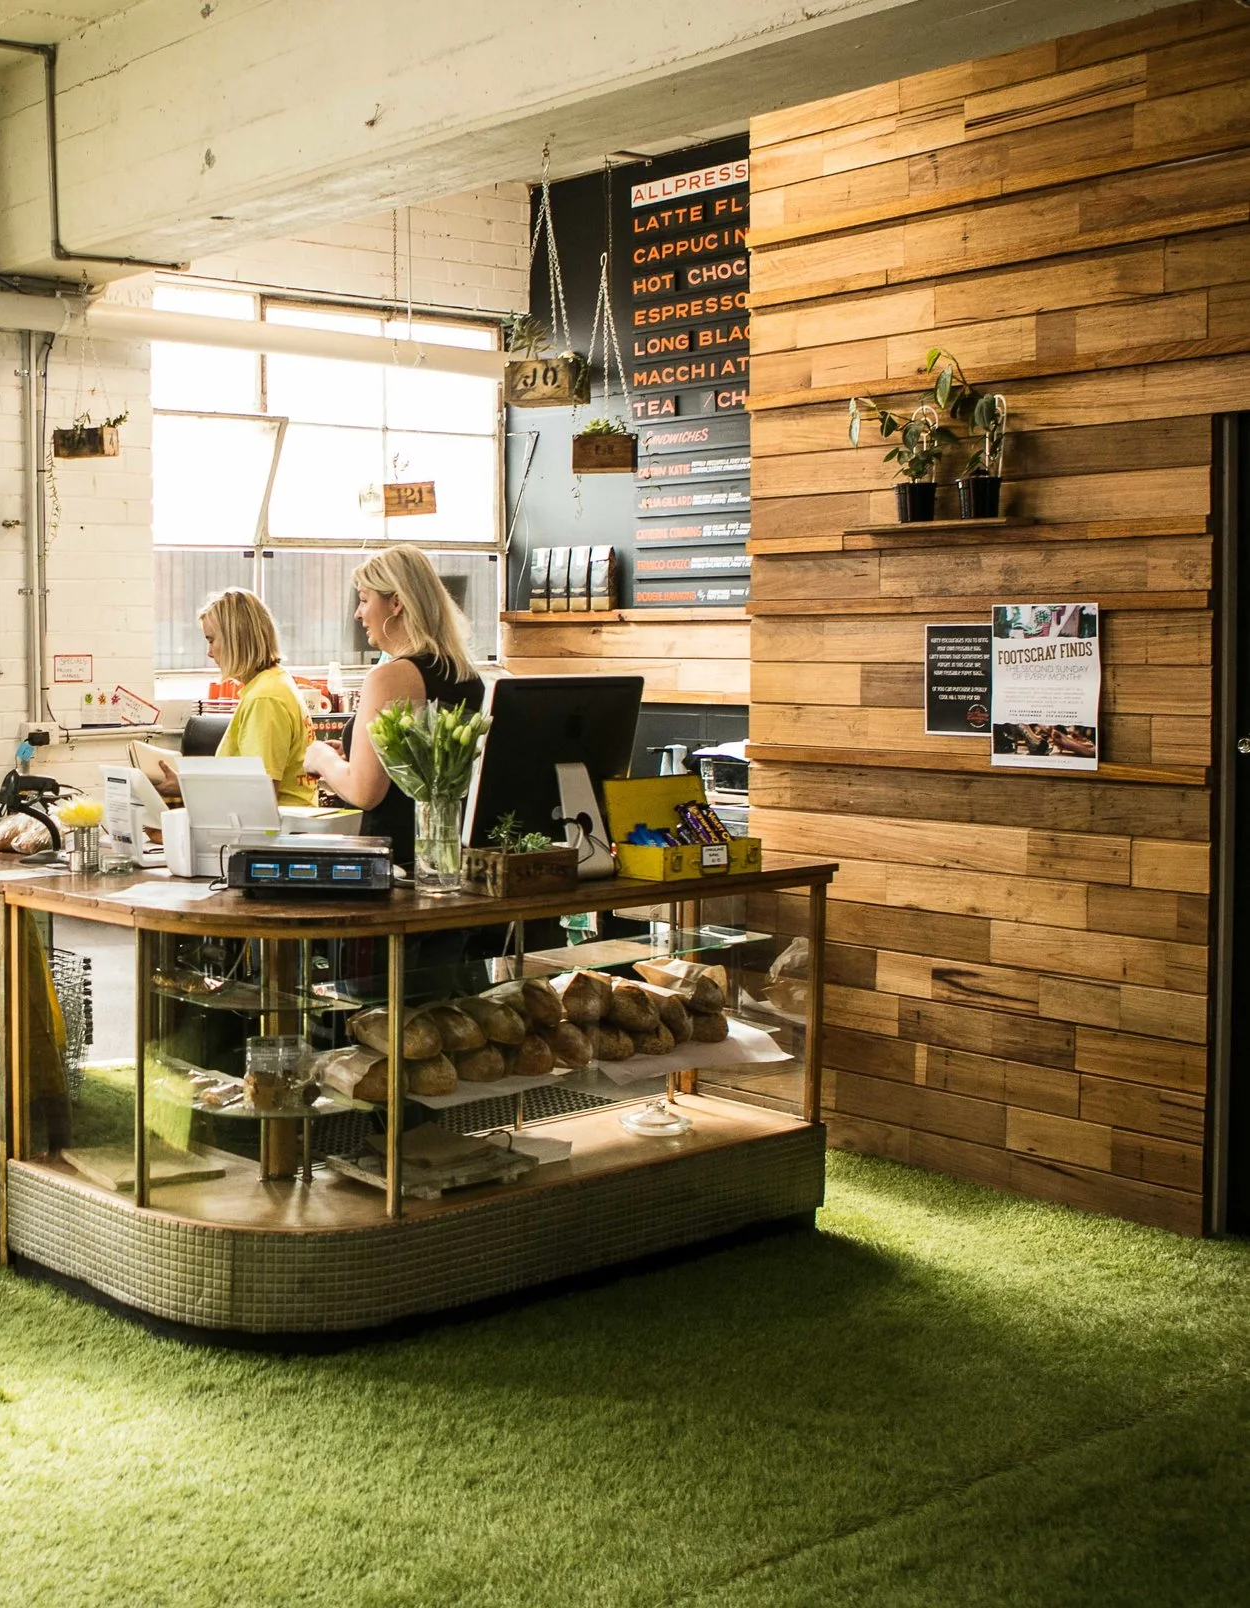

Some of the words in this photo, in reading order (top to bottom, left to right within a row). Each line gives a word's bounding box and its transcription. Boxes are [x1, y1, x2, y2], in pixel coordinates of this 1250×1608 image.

[632, 163, 747, 204] ALLPRESS
[634, 204, 703, 233] LATTE
[715, 197, 750, 216] FL
[633, 273, 674, 295] HOT
[687, 259, 747, 285] CHOC
[634, 291, 746, 326] ESPRESSO
[634, 333, 689, 357] LONG
[633, 356, 750, 387] MACCHIAT
[633, 399, 675, 418] TEA
[998, 645, 1057, 665] FOOTSCRAY
[1060, 641, 1093, 659] FINDS
[1005, 665, 1019, 673] THE
[1021, 665, 1054, 673] SECOND
[1056, 665, 1089, 673] SUNDAY
